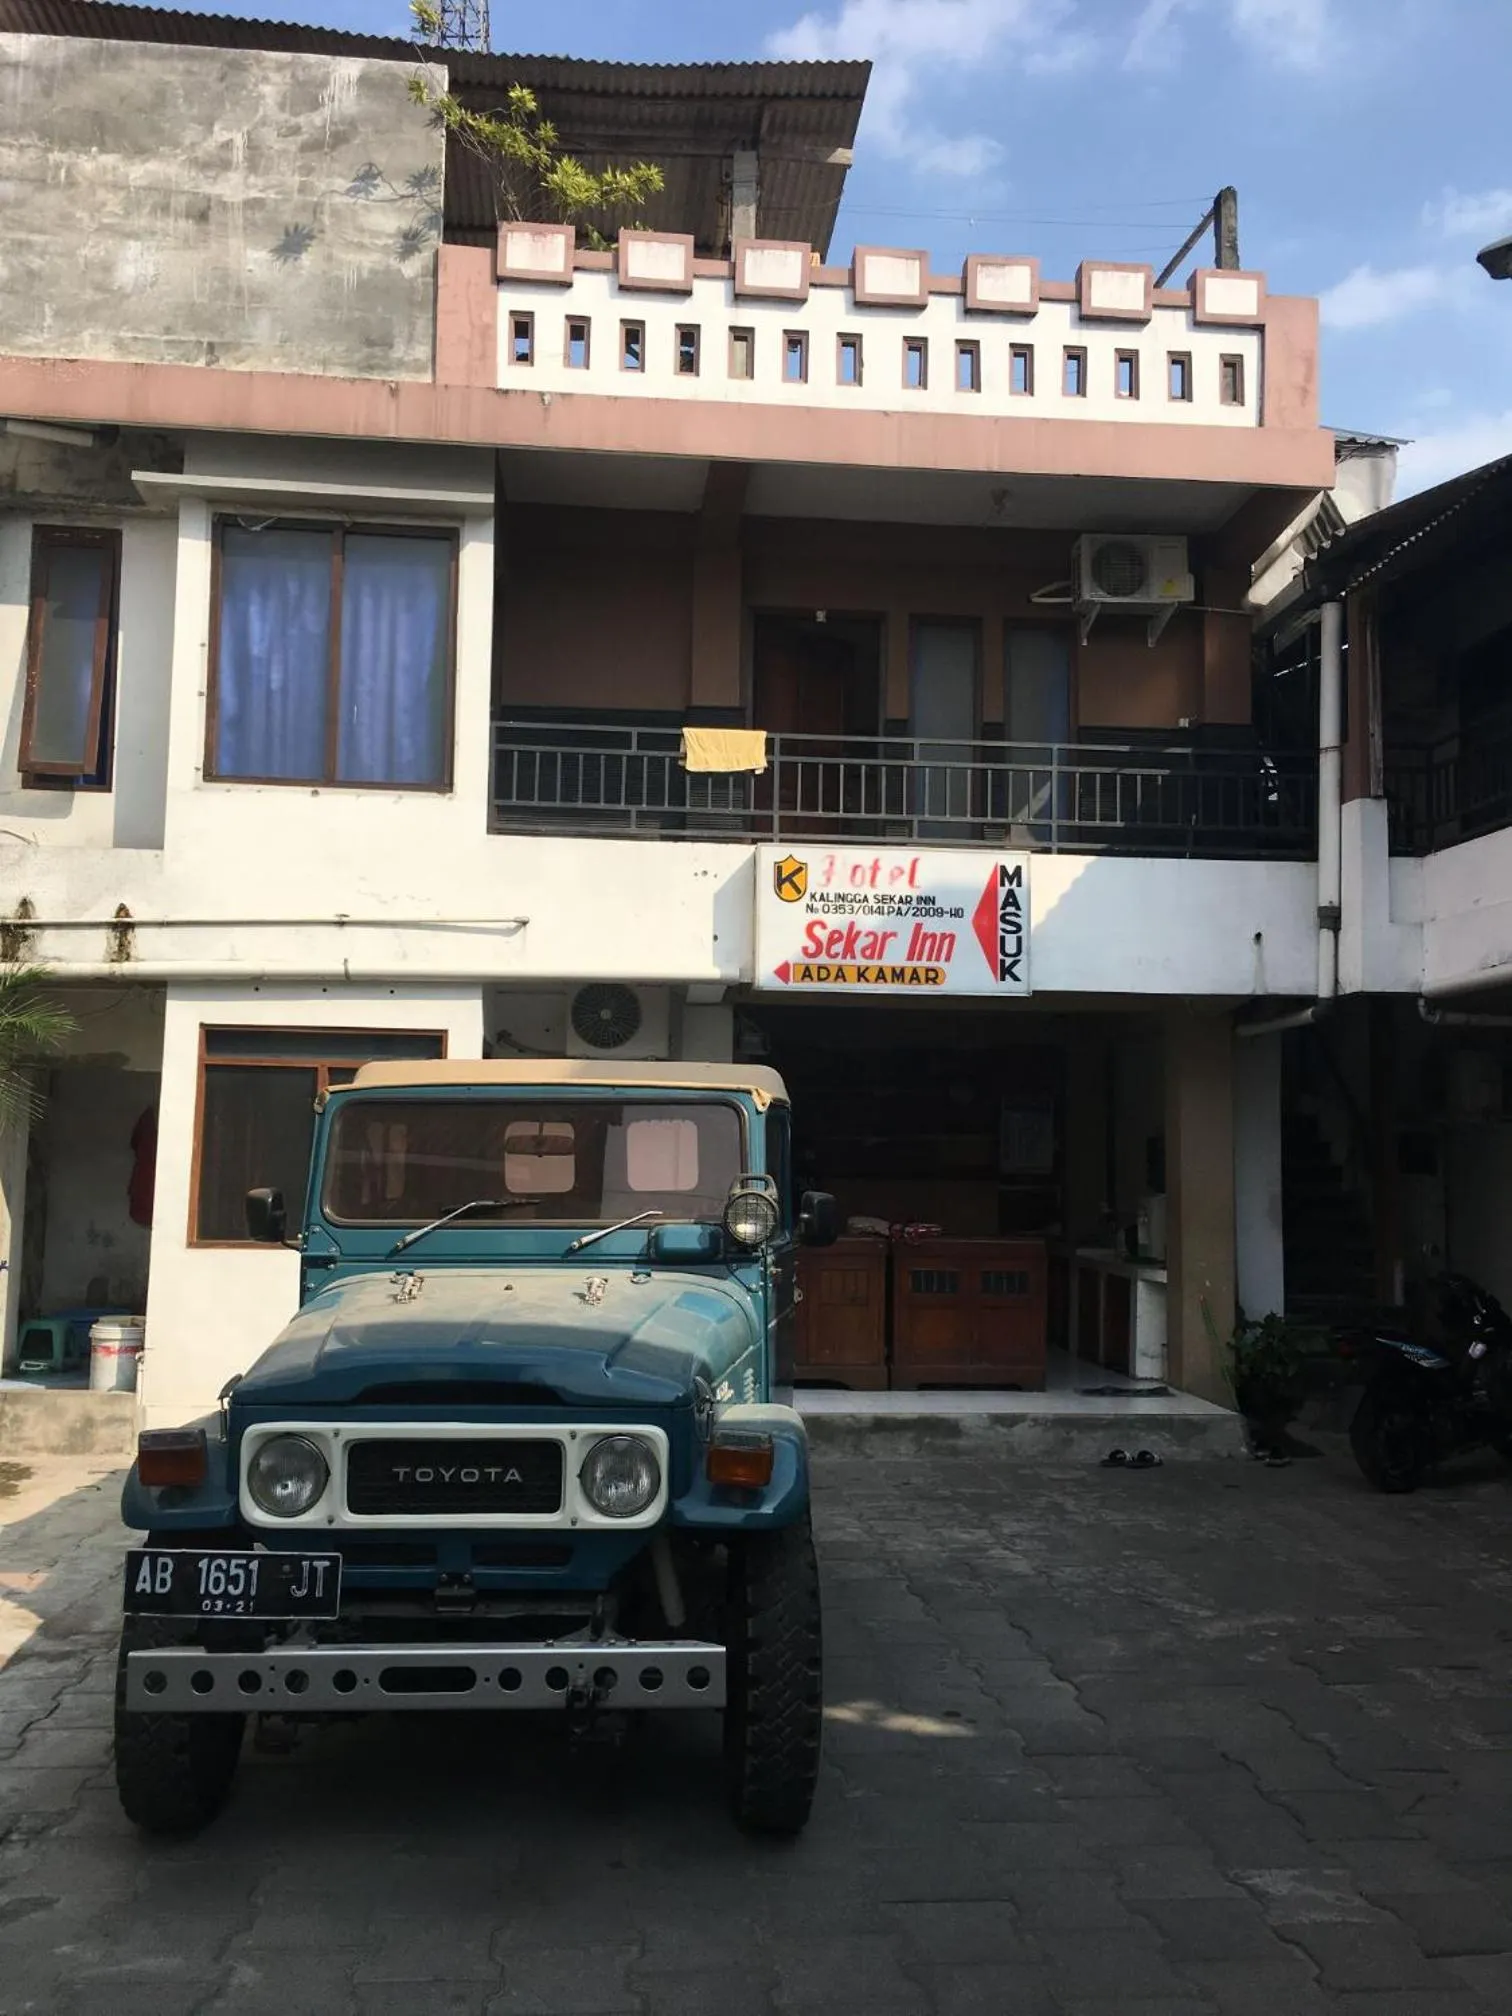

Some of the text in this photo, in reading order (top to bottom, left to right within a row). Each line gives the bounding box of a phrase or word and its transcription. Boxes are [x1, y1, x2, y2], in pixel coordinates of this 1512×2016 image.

[776, 865, 804, 895] K
[810, 892, 936, 906] KALINGGA SEKAR INN
[1000, 865, 1023, 982] MASUK
[801, 920, 957, 963] Sekar Inn
[801, 966, 939, 985] ADA KAMAR
[392, 1468, 524, 1483] TOYOTA
[135, 1556, 331, 1597] AB 1651 JT
